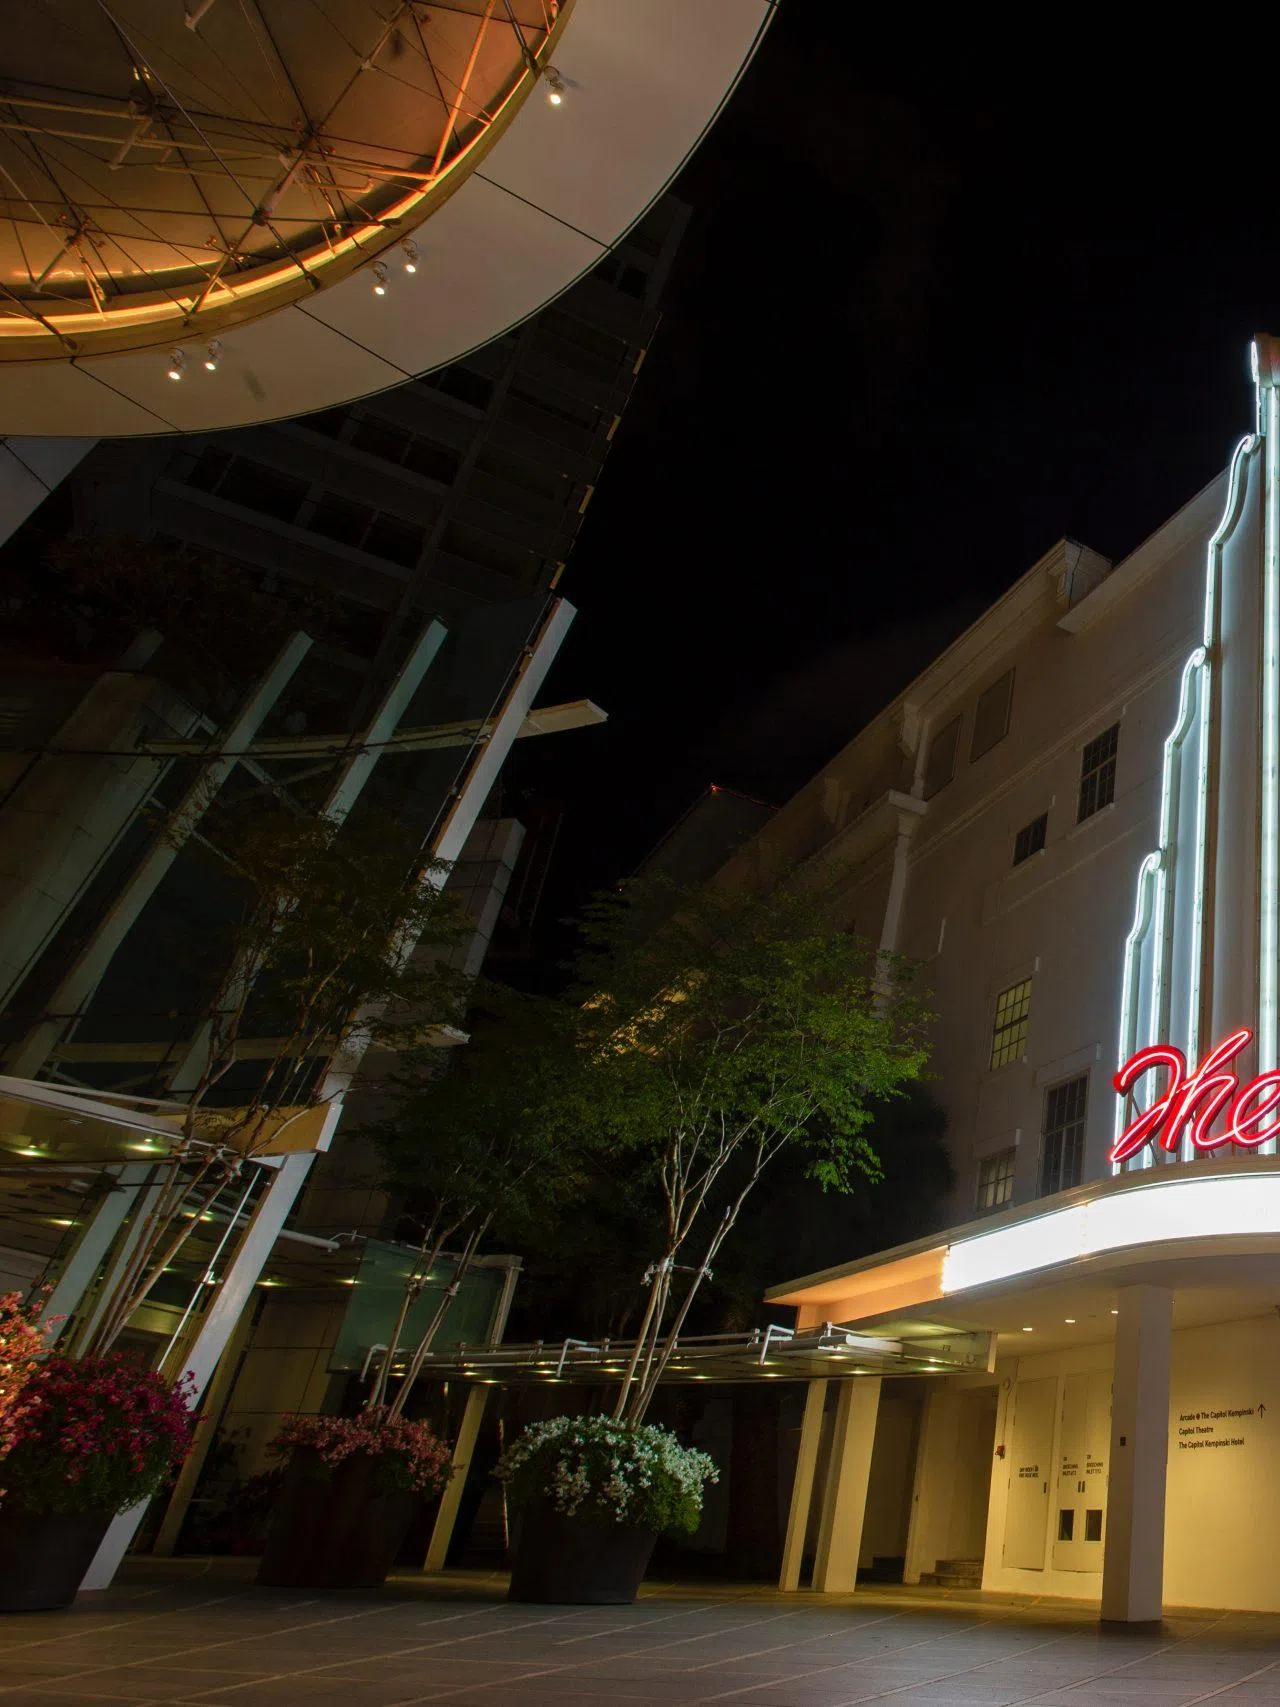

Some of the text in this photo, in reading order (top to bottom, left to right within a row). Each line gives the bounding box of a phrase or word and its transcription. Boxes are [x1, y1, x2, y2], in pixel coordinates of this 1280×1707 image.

[1180, 1413, 1196, 1421] Arcade
[1201, 1411, 1210, 1420] The
[1210, 1410, 1227, 1420] Capitol
[1227, 1408, 1255, 1418] Kempinski
[1178, 1426, 1214, 1436] Capitol Theatre
[1178, 1437, 1245, 1450] The Capitol Kempinski Hotel
